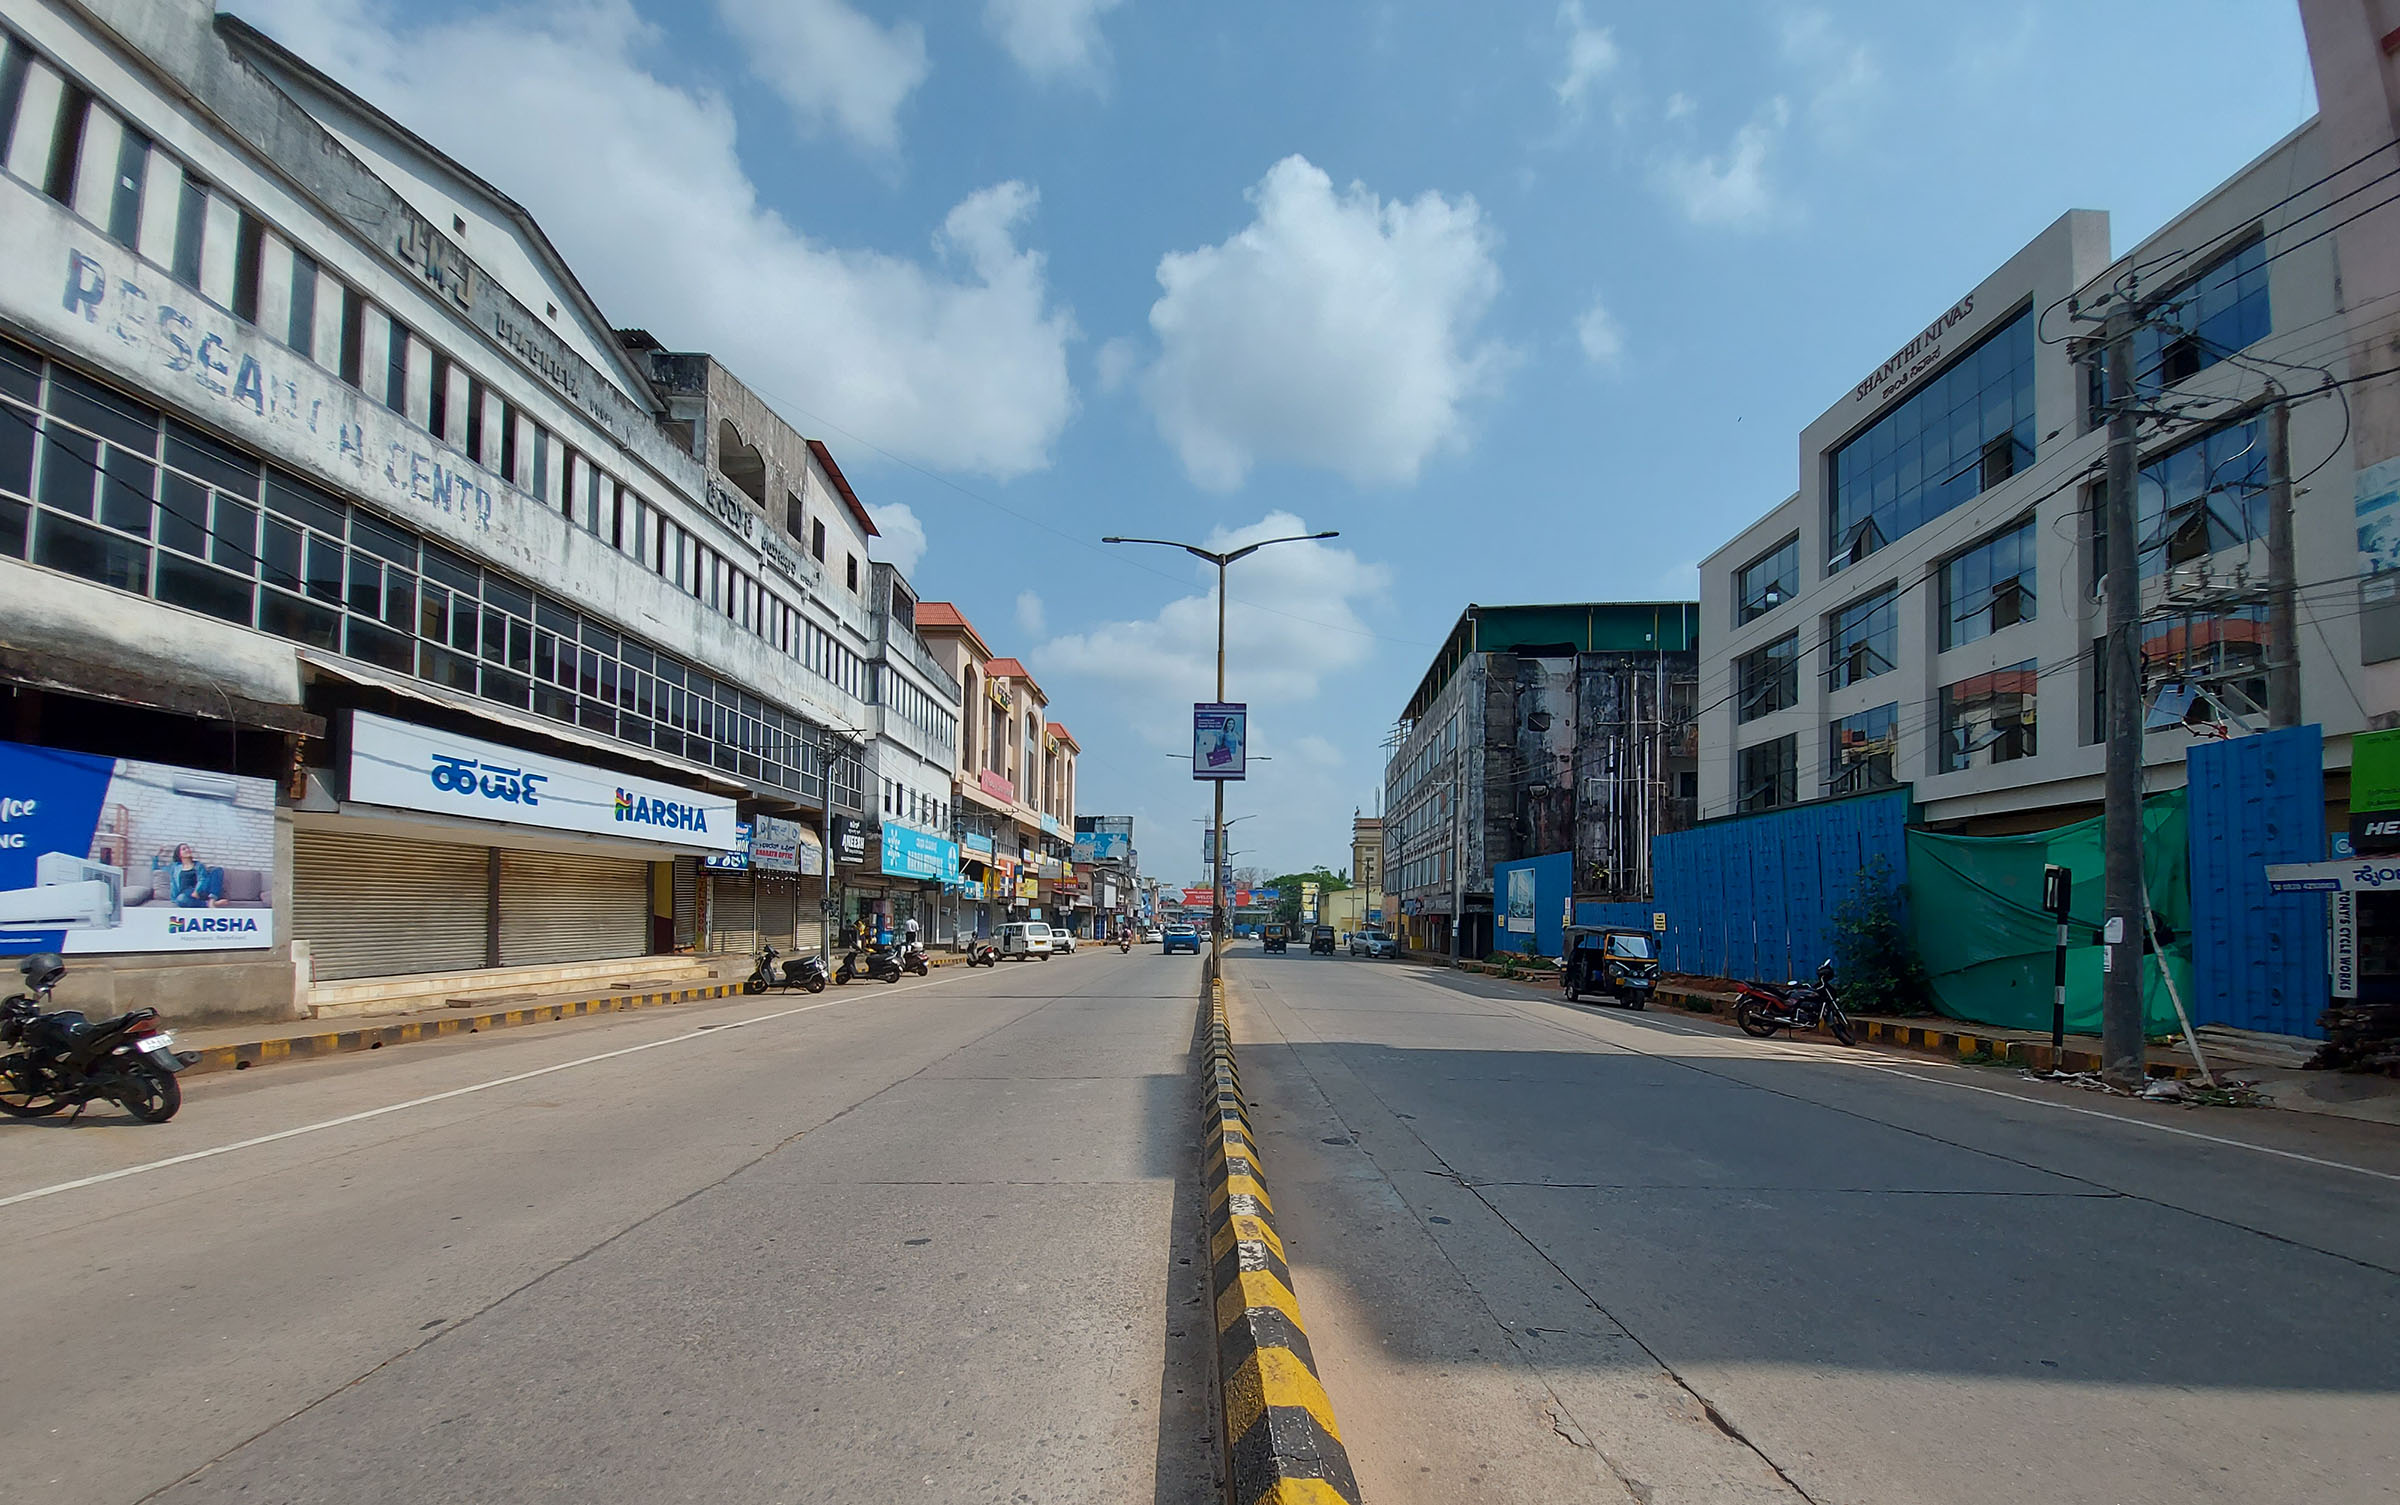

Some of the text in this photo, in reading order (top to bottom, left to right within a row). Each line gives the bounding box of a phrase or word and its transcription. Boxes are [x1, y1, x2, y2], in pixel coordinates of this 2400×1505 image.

[1856, 294, 1975, 402] SHANTHI NIVAS
[615, 787, 708, 833] HARSHA
[168, 916, 258, 933] HARSHA
[2339, 926, 2351, 953] CYCLE
[2339, 956, 2351, 991] WORKS
